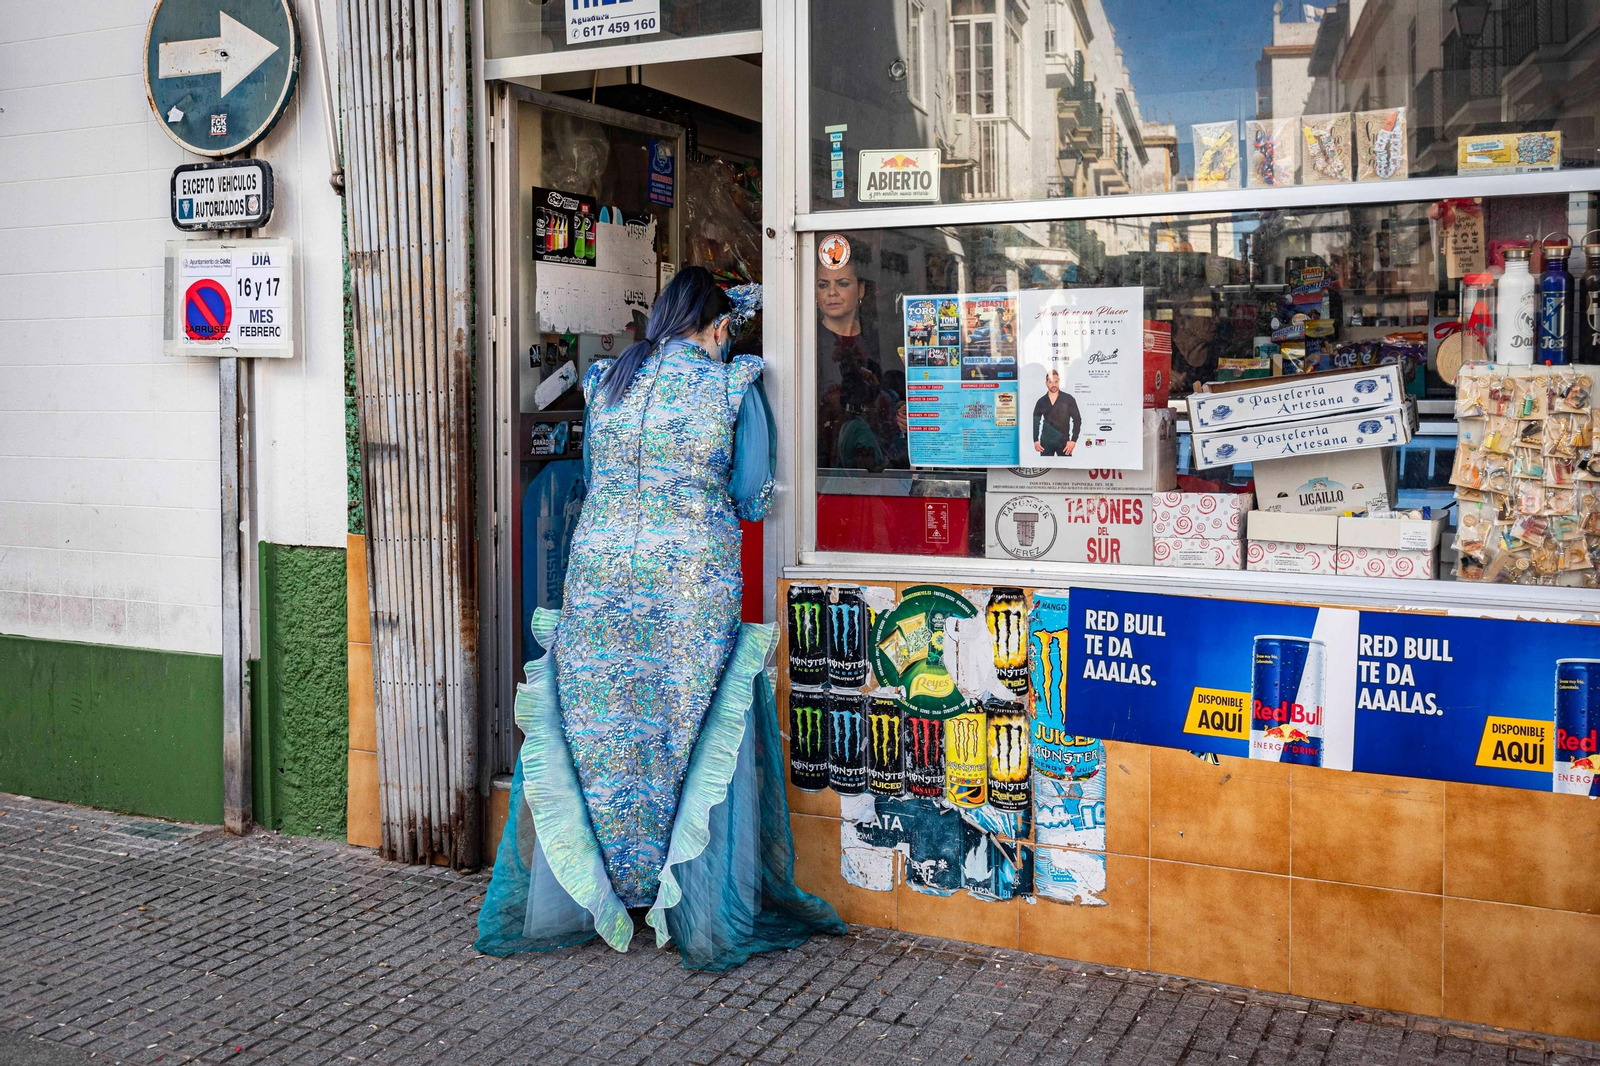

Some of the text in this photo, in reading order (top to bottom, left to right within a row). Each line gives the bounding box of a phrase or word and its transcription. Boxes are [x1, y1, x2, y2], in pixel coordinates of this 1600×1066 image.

[583, 18, 656, 38] 617 459 160
[211, 118, 226, 126] FCK
[211, 125, 227, 133] NZS
[182, 174, 257, 195] EXCEPTO VEHICULOS
[866, 170, 932, 191] ABIERTO
[195, 199, 245, 218] AUTORIZADOS
[1302, 267, 1324, 275] GRATIS
[238, 278, 280, 301] 16 y 17
[1292, 278, 1331, 296] PHOSKITOS
[249, 309, 274, 324] MES
[908, 307, 936, 315] TORO
[1096, 305, 1129, 317] Placer
[1467, 301, 1493, 328] A
[183, 325, 231, 334] CARRUSEL
[240, 326, 281, 338] FEBRERO
[1074, 328, 1116, 336] CORTÉS
[1272, 325, 1305, 340] PHOSKITO
[183, 337, 194, 345] DE
[1250, 385, 1326, 410] Pasteleria
[1277, 395, 1344, 415] Artesana
[1253, 425, 1329, 449] Pasteleria
[1281, 434, 1348, 454] Artesana
[1299, 490, 1344, 506] LIGAILLO
[1002, 499, 1050, 519] TAPONSUR
[1065, 497, 1143, 525] TAPONES
[1098, 526, 1110, 536] DEL
[1010, 546, 1042, 557] JEREZ
[1087, 538, 1121, 564] SUR
[1042, 602, 1067, 611] MANGO
[1084, 609, 1166, 637] RED BULL
[1084, 633, 1134, 659] TE DA
[1358, 633, 1453, 663] RED BULL
[789, 656, 827, 667] MONSTER
[827, 657, 866, 670] MONSTER
[830, 668, 864, 676] ENERGY
[1083, 659, 1157, 687] AAALAS.
[1358, 660, 1416, 687] TE DA
[915, 676, 950, 691] Reyes
[1197, 693, 1243, 708] DISPONIBLE
[1358, 687, 1444, 717] AAALAS.
[1197, 708, 1243, 733] AQUÍ
[1253, 699, 1323, 727] Red Bull
[1492, 723, 1545, 738] DISPONIBLE
[1253, 740, 1319, 756] ENERGY DRINK
[1556, 728, 1598, 753] Red
[1032, 743, 1099, 765] MONSTER
[1492, 738, 1545, 765] AQUÍ
[791, 759, 828, 772] MONSTER
[828, 763, 867, 777] MONSTER
[946, 760, 986, 772] MONSTER
[831, 773, 864, 782] ENERGY
[867, 768, 906, 781] MONSTER
[905, 771, 946, 785] MONSTER
[1558, 773, 1600, 785] ENERGY
[871, 780, 902, 789] JUICED
[911, 784, 941, 797] ASSAULT
[988, 778, 1029, 791] MONSTER
[992, 789, 1027, 801] Rehab
